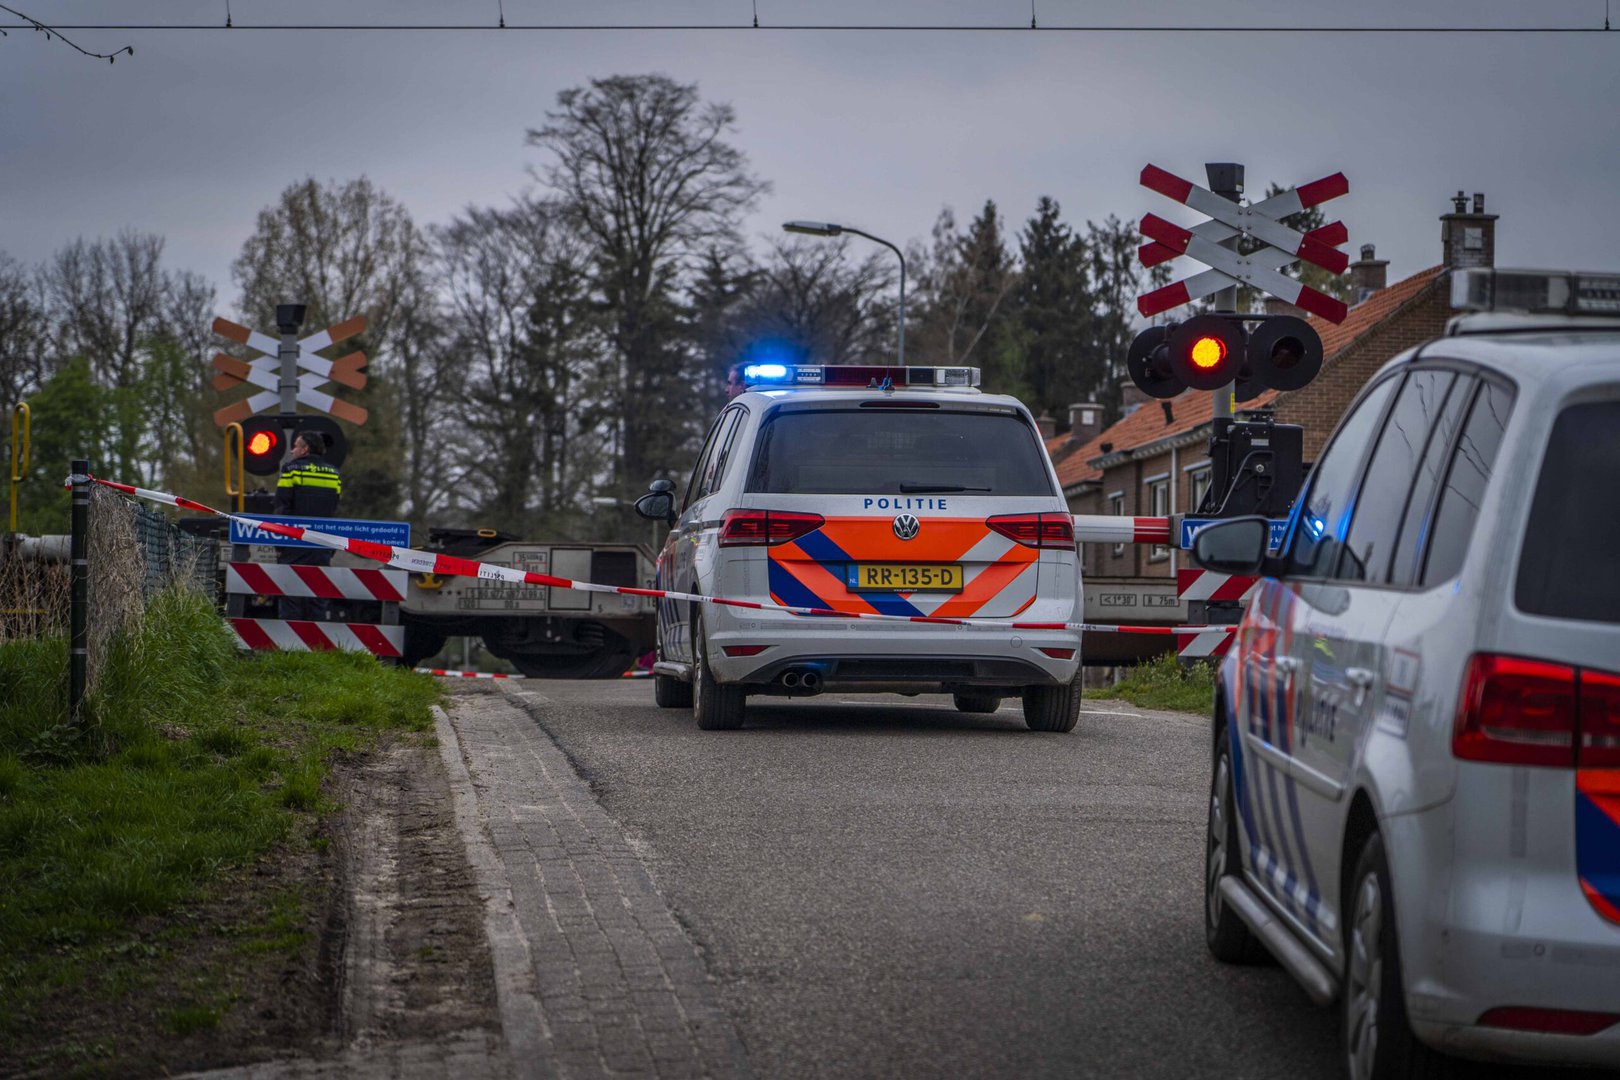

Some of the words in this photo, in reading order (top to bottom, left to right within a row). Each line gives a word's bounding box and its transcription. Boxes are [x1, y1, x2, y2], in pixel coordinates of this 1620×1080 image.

[864, 498, 947, 510] POLITIE
[236, 521, 312, 541] WAC
[867, 567, 953, 586] RR-135-D
